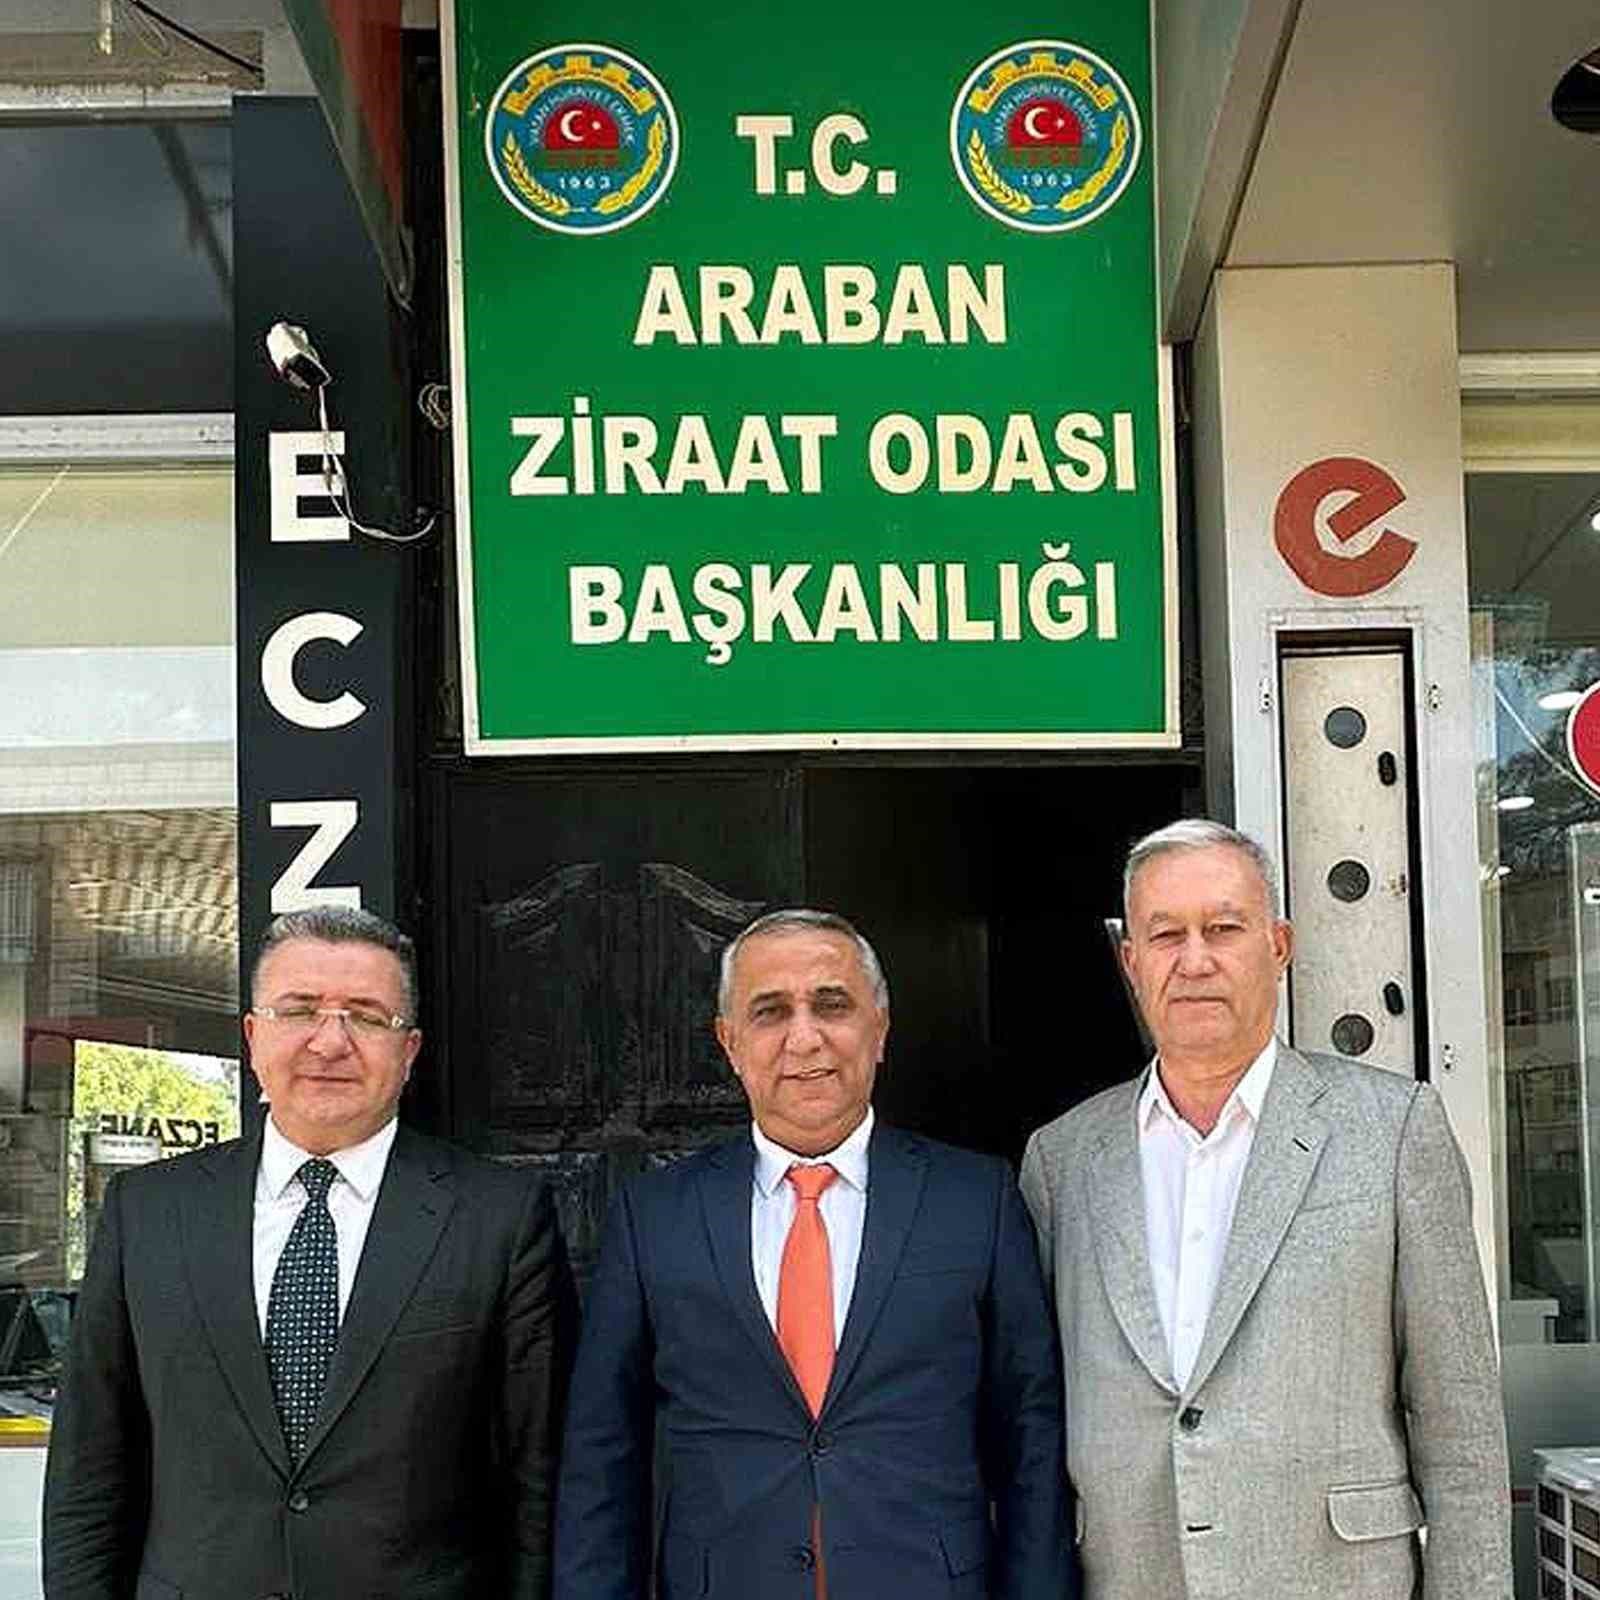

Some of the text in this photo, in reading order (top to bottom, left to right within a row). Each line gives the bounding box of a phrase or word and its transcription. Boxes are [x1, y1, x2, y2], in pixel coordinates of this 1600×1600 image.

[736, 113, 897, 196] T.C.
[634, 264, 1007, 346] ARABAN
[509, 396, 1137, 497] ZİRAAT ODASI
[569, 542, 1118, 665] BAŞKANLIĞI
[261, 431, 366, 914] ECZ
